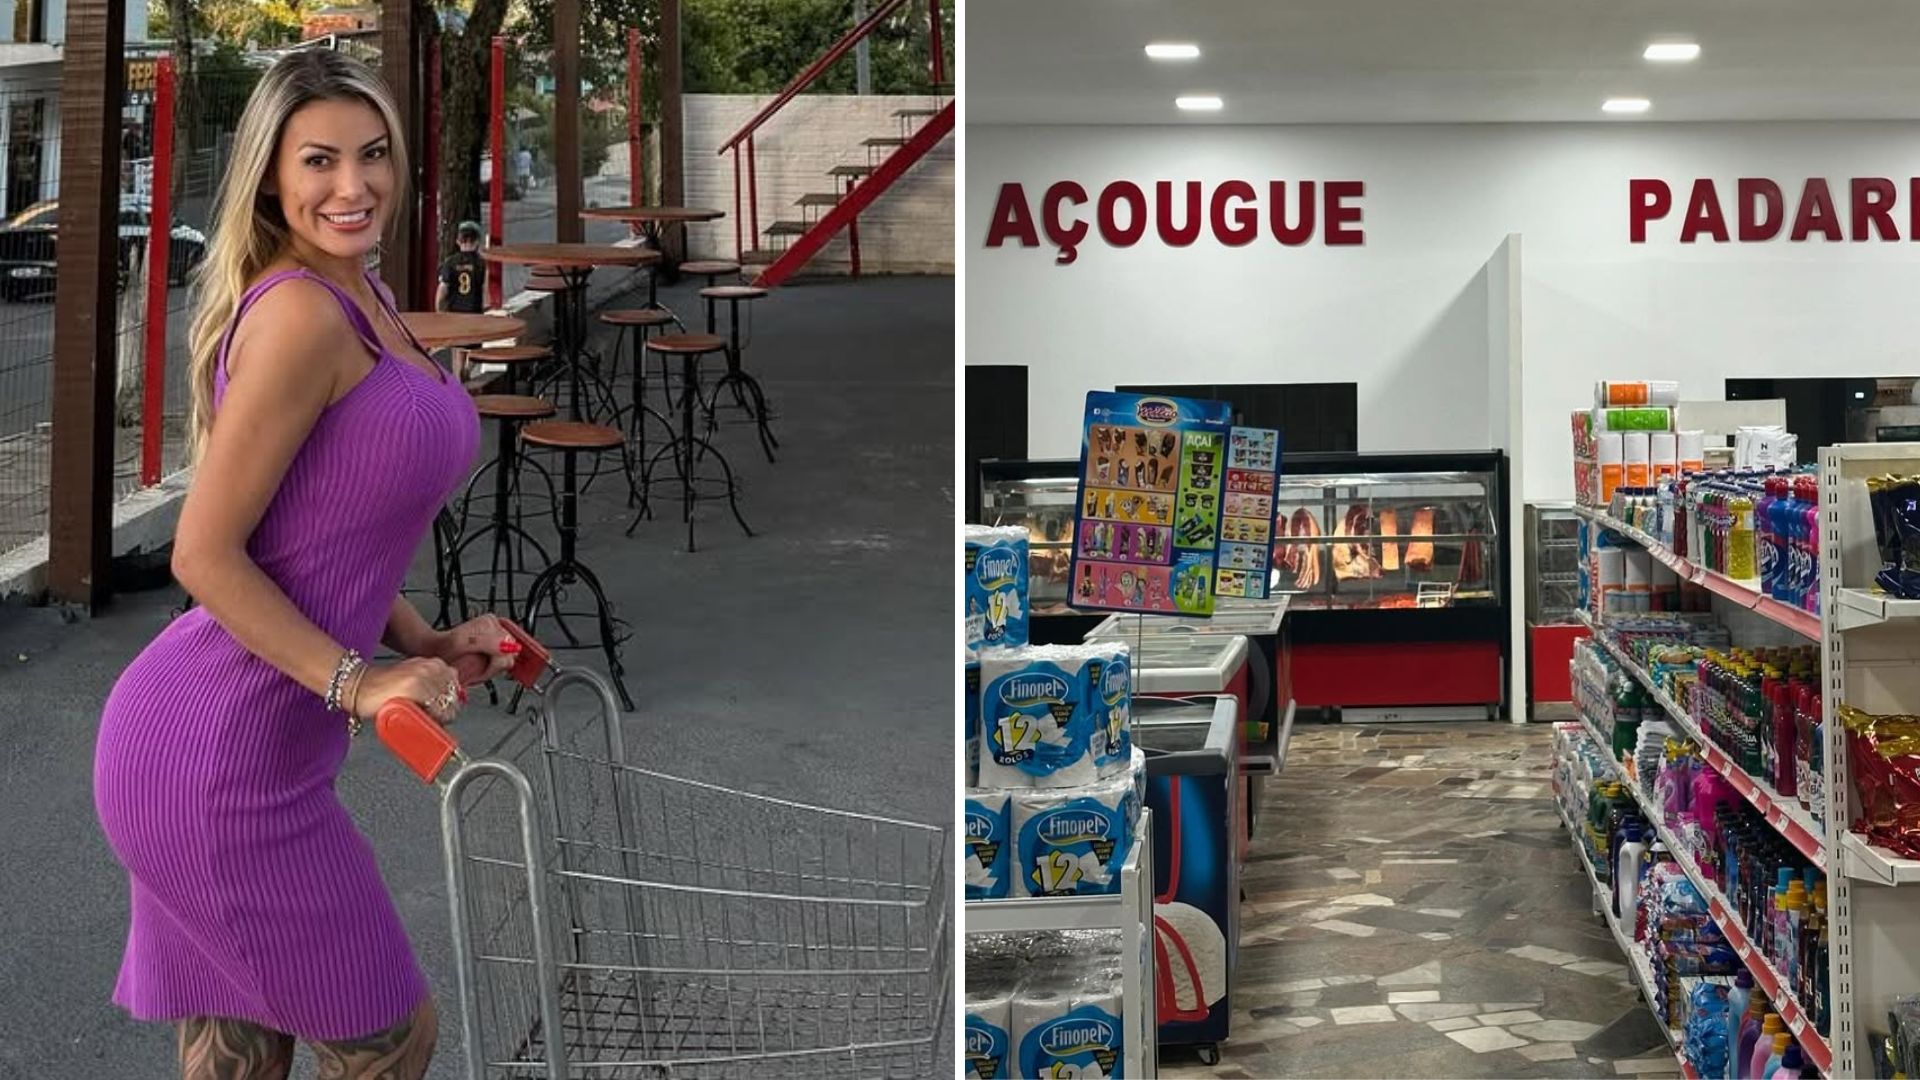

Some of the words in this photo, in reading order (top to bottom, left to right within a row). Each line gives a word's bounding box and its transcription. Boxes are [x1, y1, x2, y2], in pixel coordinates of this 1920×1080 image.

[986, 180, 1364, 264] AÇOUGUE
[982, 554, 1016, 580] Finopel
[1005, 679, 1064, 699] Finopel
[998, 714, 1037, 752] 12
[999, 751, 1029, 764] ROLOS
[1044, 815, 1106, 837] Finopel
[1036, 853, 1077, 892] 12
[1047, 1023, 1110, 1047] Finopel
